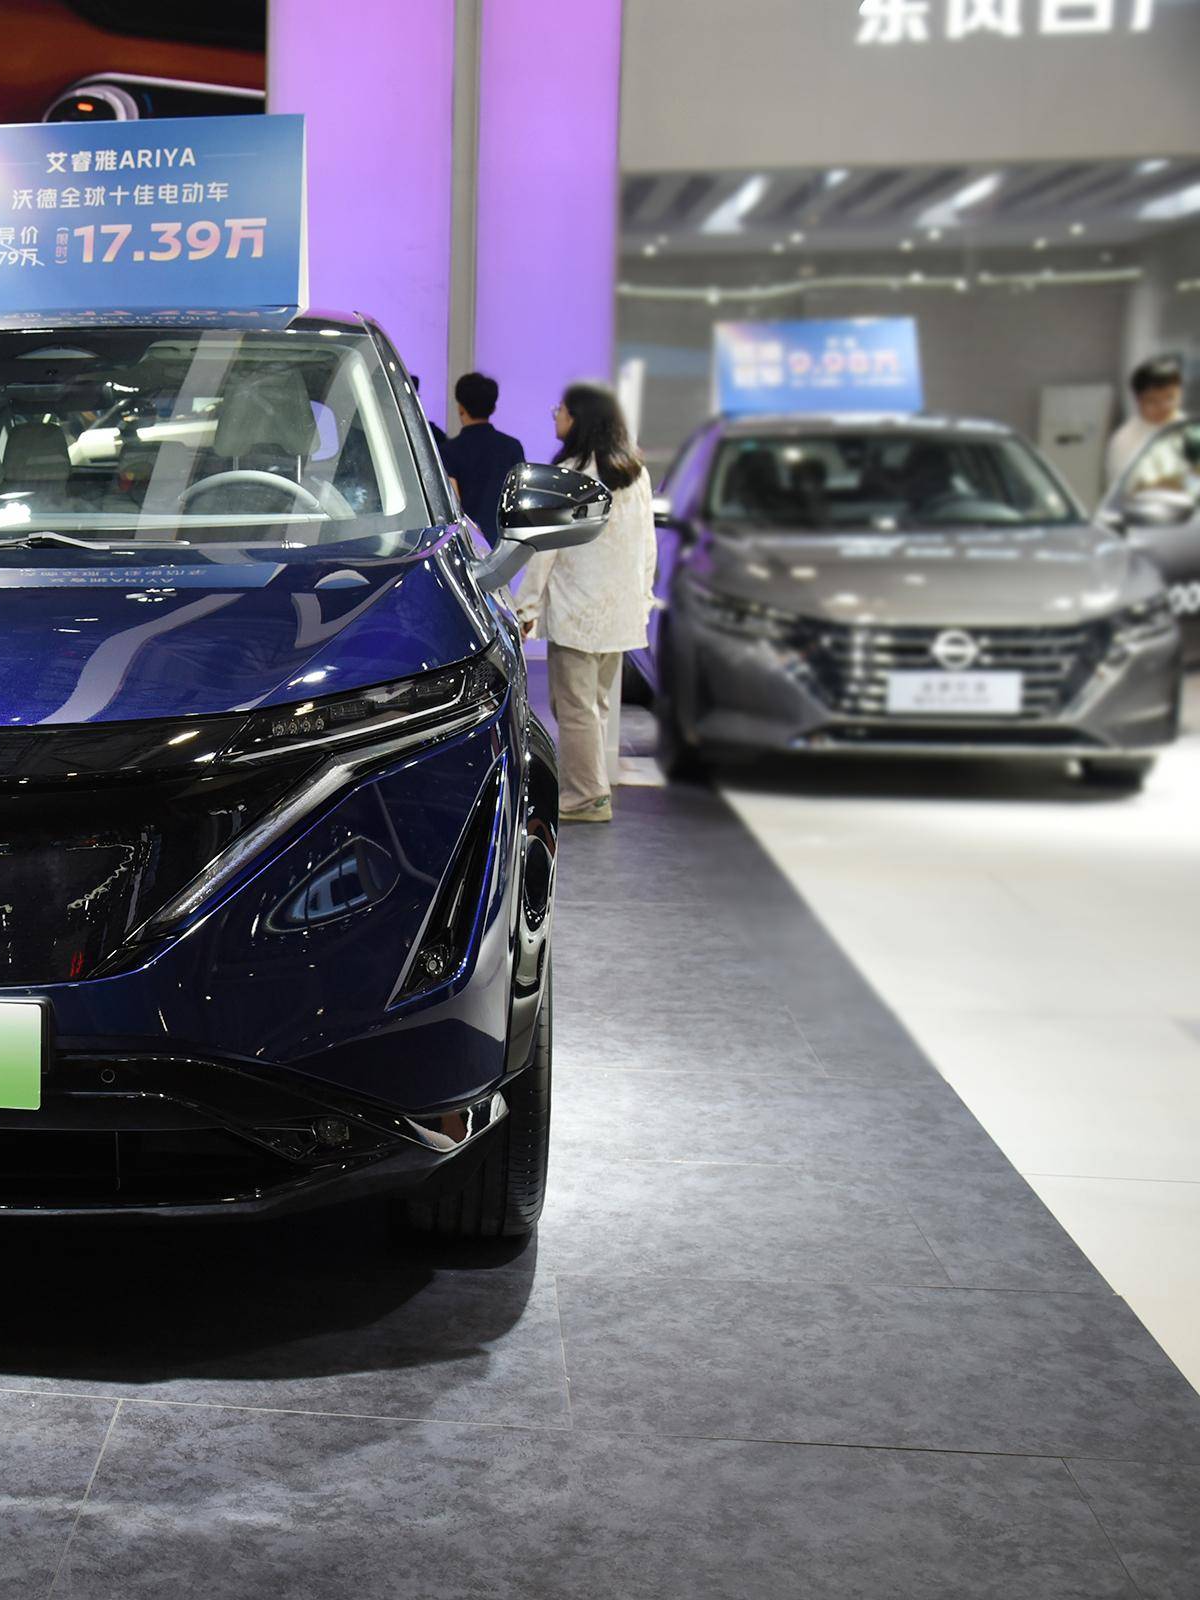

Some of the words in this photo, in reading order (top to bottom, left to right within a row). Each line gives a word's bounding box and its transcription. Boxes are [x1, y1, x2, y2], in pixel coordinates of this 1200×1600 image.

[46, 147, 197, 174] 艾睿雅ARIYA
[12, 181, 230, 211] 沃德全球十佳电动车
[74, 217, 268, 264] 17.39万
